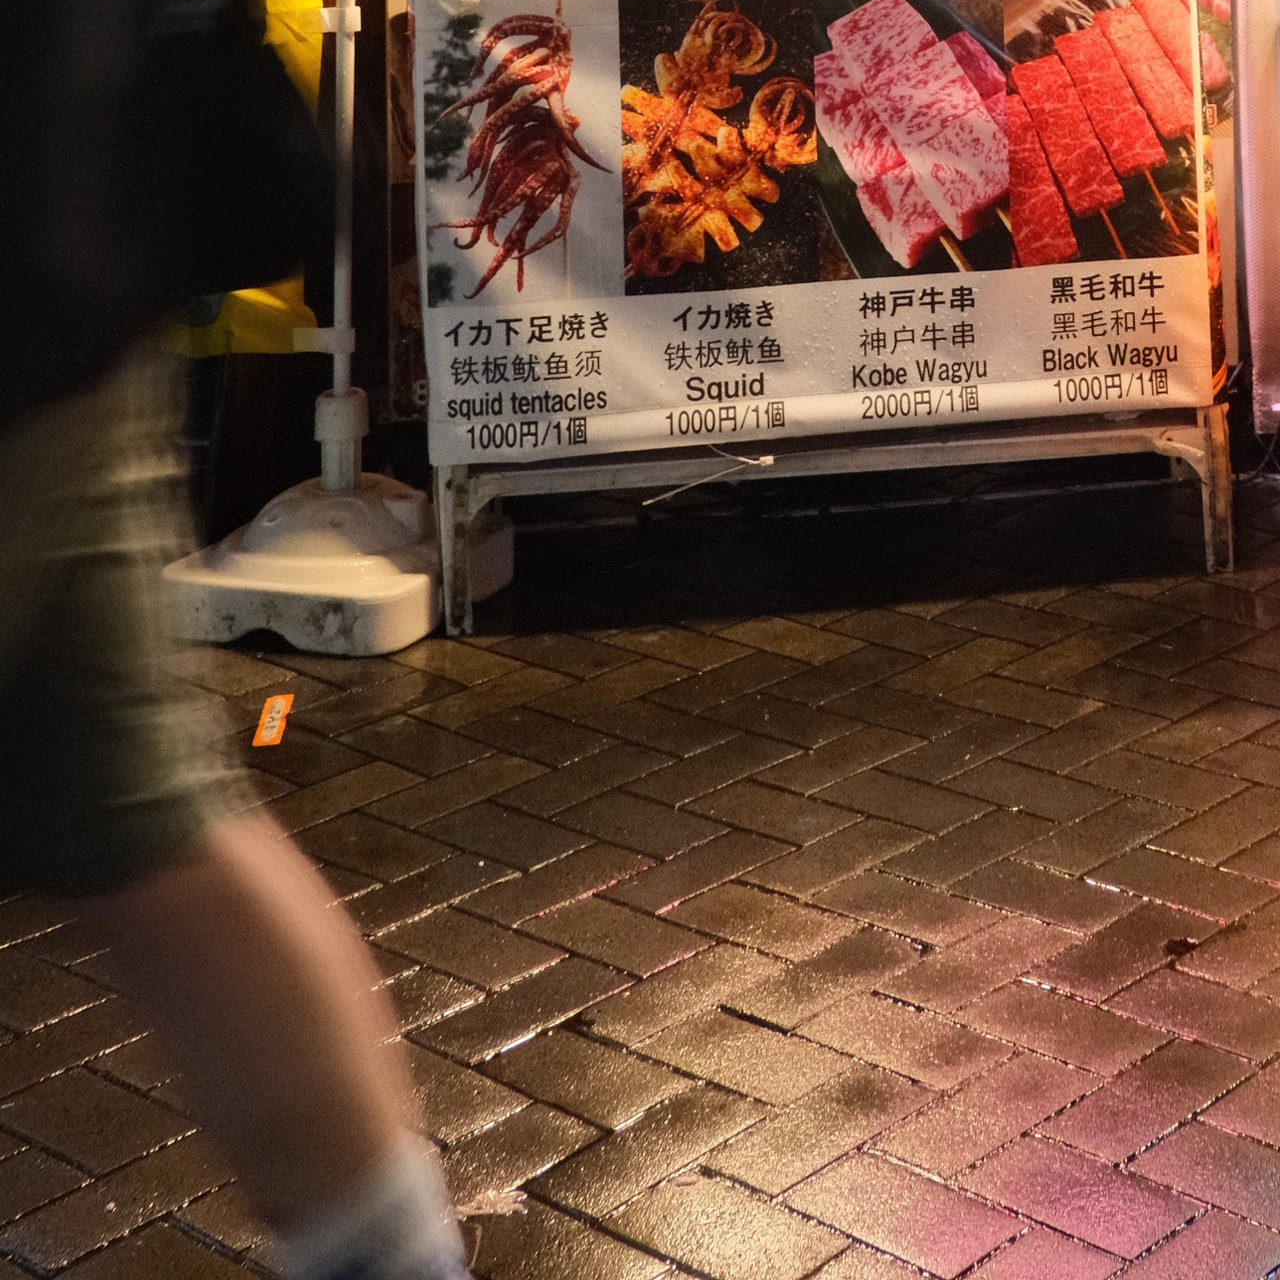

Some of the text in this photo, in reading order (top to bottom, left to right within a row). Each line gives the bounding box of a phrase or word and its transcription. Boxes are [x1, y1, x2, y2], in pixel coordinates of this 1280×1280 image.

[673, 301, 775, 332] イカ焼き
[859, 286, 976, 319] 神戸牛串
[444, 312, 609, 346] イカ下足焼き
[859, 321, 976, 357] 神户牛串
[1051, 306, 1167, 340] 黑毛和牛
[451, 350, 602, 386] 铁板鱿鱼须
[664, 336, 785, 371] 铁板鱿鱼
[1042, 343, 1179, 373] Black Wagyu
[686, 373, 765, 402] Squid
[852, 358, 988, 388] Kobe Wagyu
[1054, 369, 1169, 404] 1000円/1個
[447, 387, 608, 420] squid tentacles
[665, 401, 785, 436] 1000円/1個
[862, 386, 979, 419] 2000円/1個
[467, 417, 588, 450] 1000円/1個
